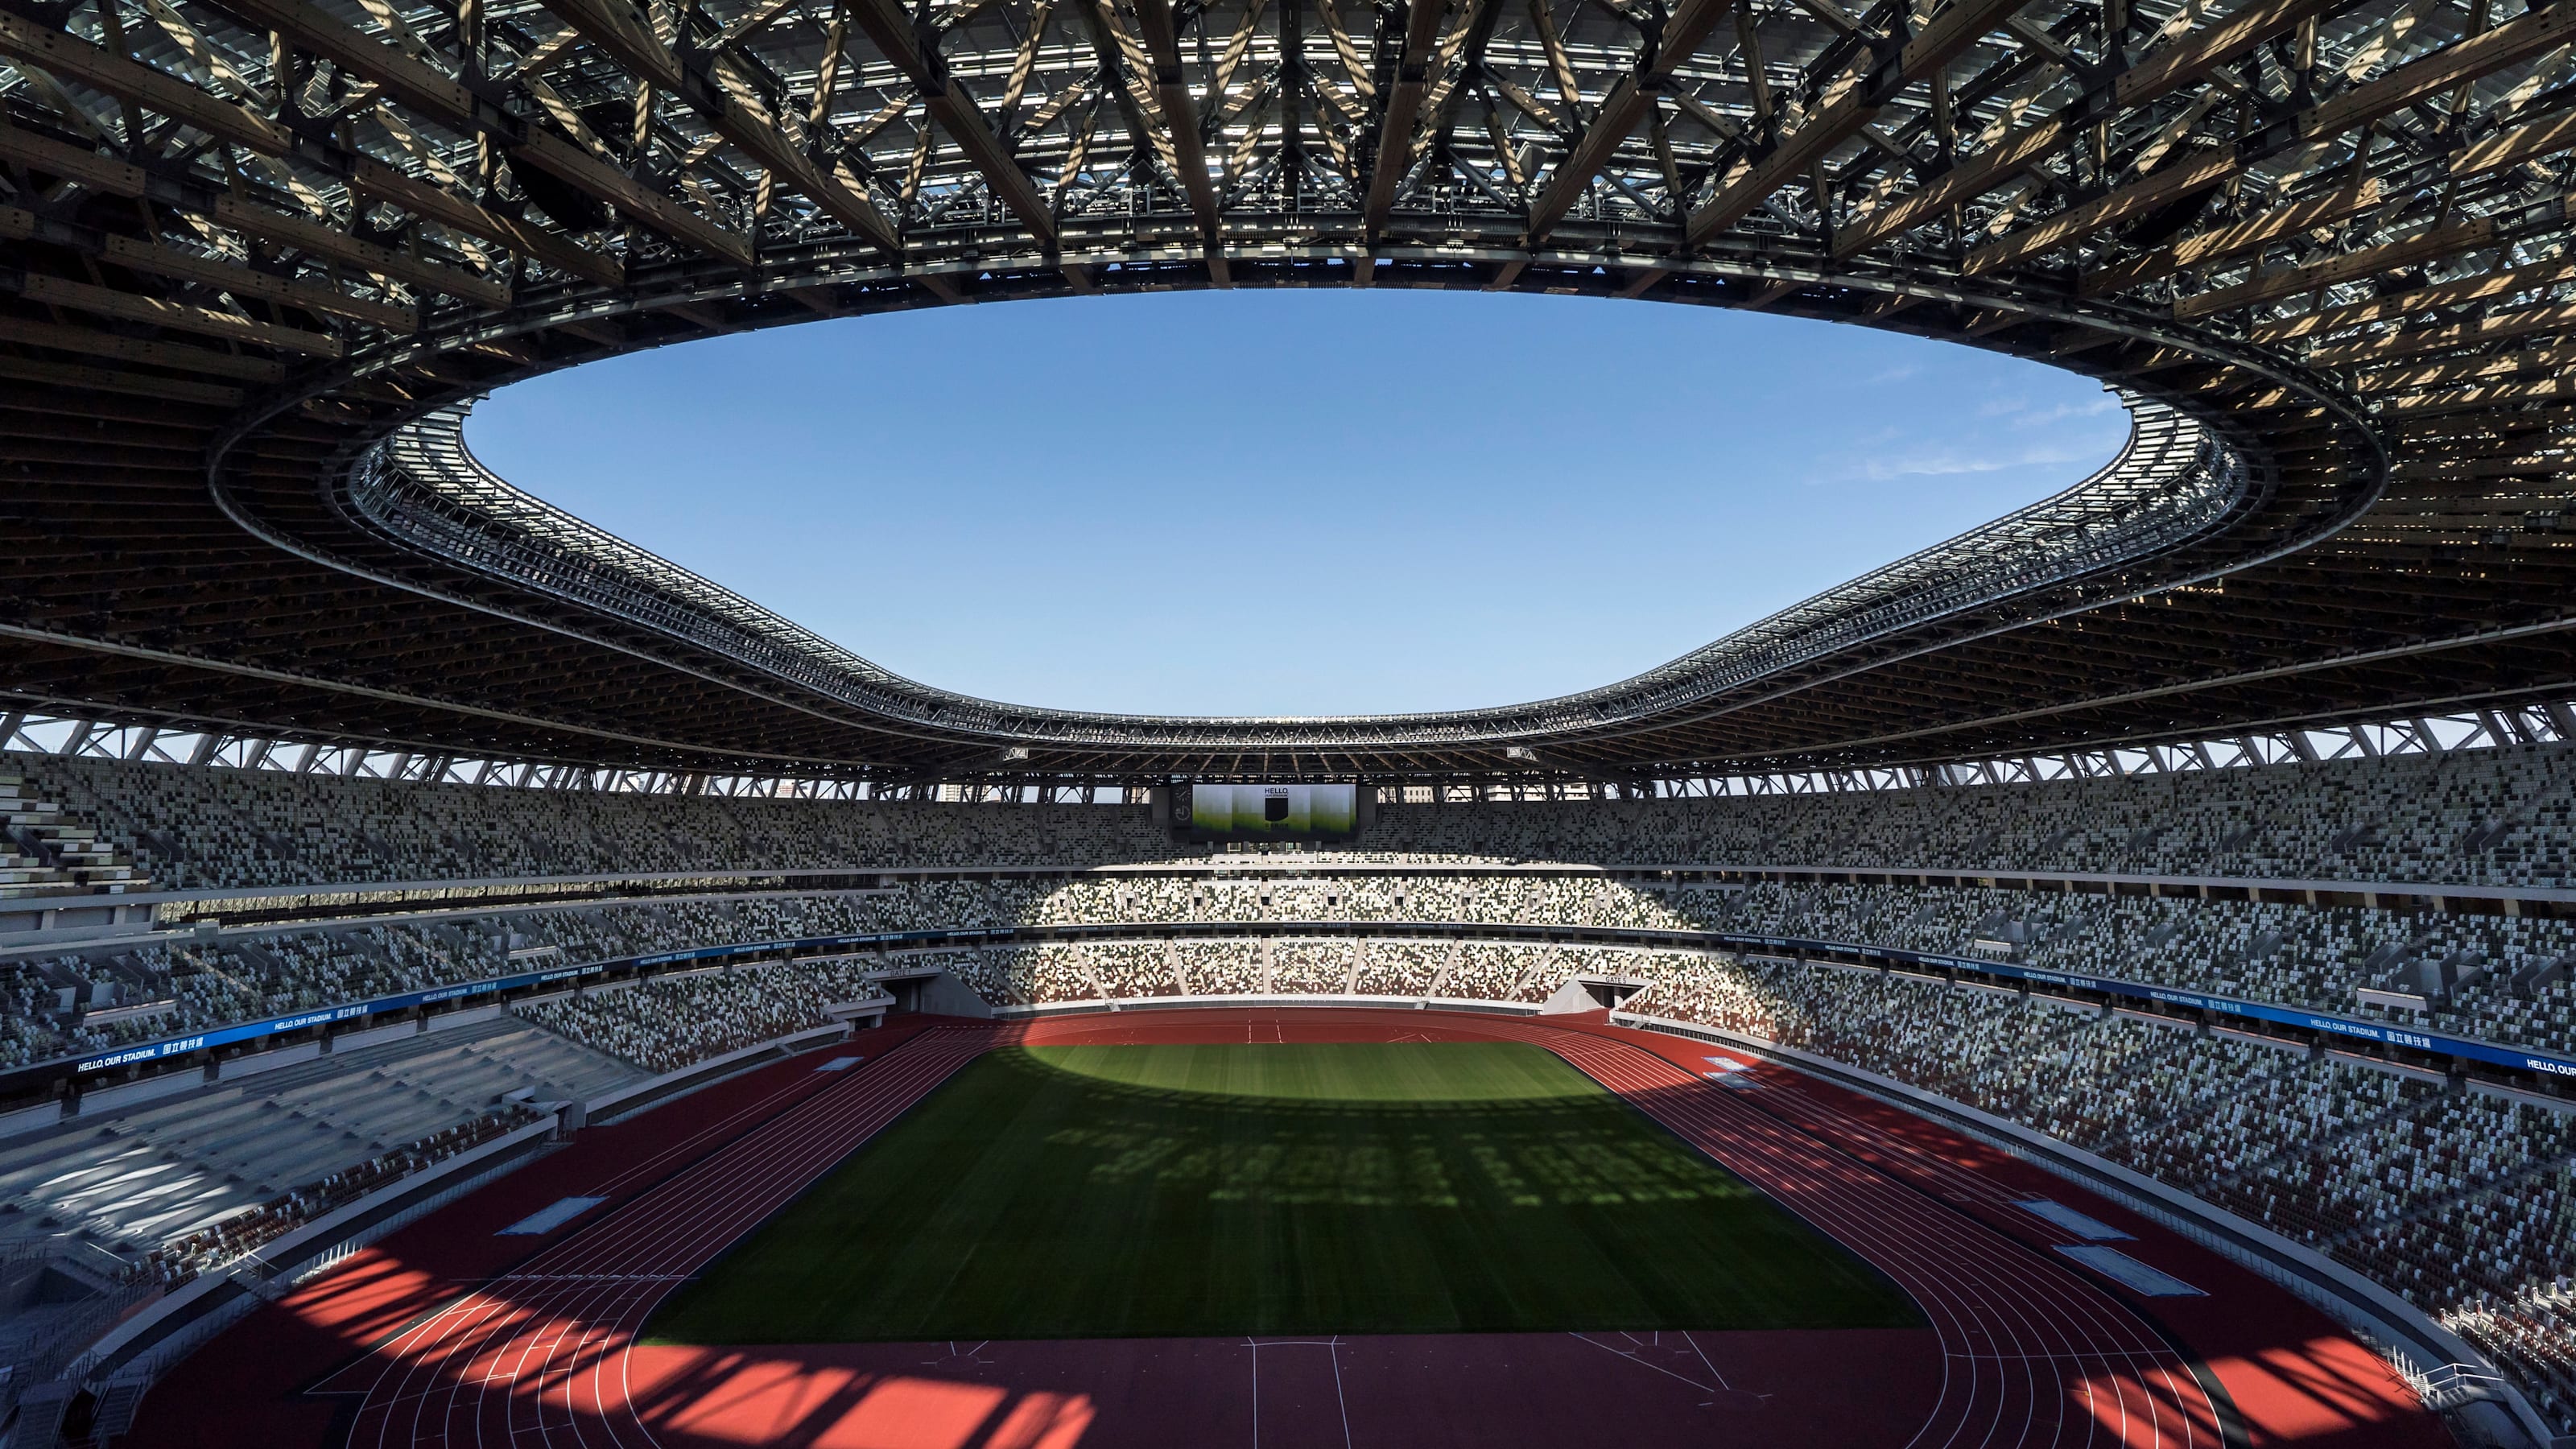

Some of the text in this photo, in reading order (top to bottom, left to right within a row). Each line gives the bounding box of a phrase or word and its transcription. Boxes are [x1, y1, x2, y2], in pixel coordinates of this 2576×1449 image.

[294, 1018, 306, 1026] OUR
[2332, 1022, 2347, 1031] OUR
[2348, 1026, 2380, 1038] STADIUM.
[105, 1056, 121, 1067] OUR
[122, 1049, 156, 1063] STADIUM.
[2557, 1065, 2576, 1076] OUR
